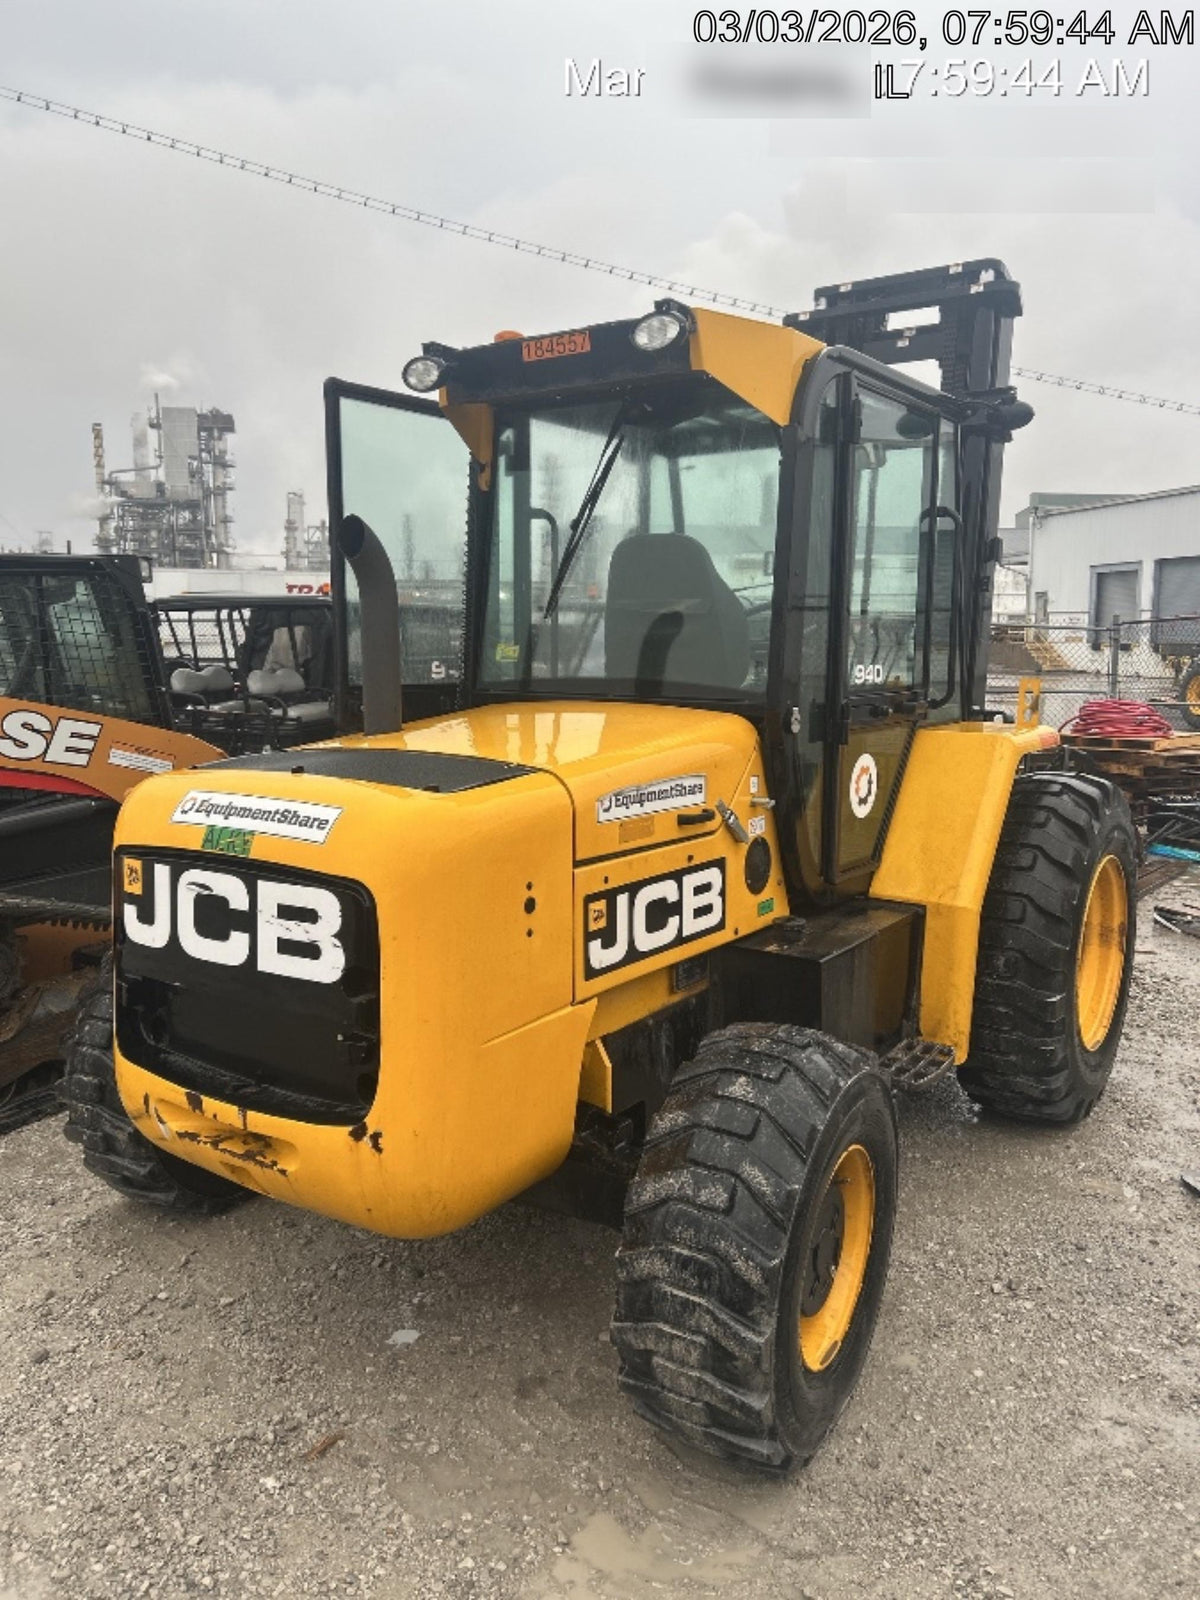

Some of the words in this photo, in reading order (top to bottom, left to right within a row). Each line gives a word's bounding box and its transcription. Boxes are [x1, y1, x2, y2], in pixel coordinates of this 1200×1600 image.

[524, 332, 588, 359] 184557
[854, 664, 883, 684] 940
[614, 782, 704, 809] EquipmentShare
[194, 797, 330, 832] EquipmentShare
[123, 863, 346, 984] JCB
[588, 867, 723, 969] JCB
